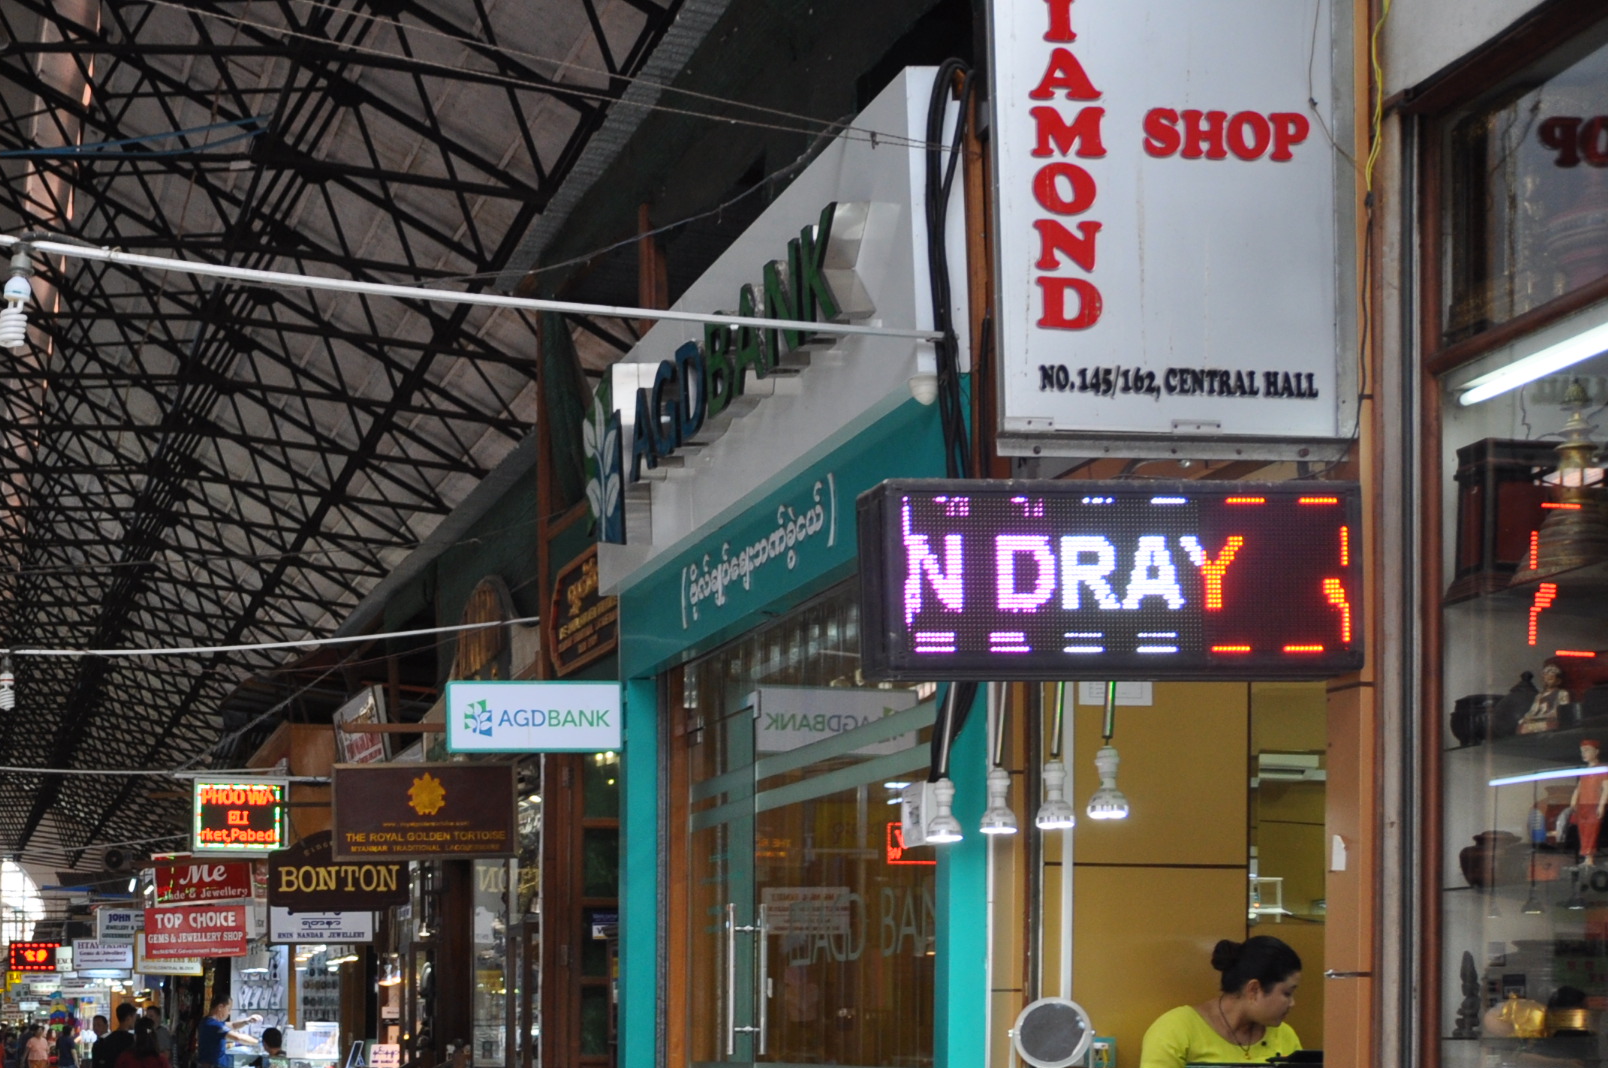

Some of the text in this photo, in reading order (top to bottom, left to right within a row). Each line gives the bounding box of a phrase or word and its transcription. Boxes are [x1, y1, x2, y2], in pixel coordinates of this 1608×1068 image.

[1142, 107, 1310, 162] SHOP
[630, 201, 842, 484] AGDBANK
[1163, 367, 1260, 398] CENTRAL
[1262, 370, 1319, 400] HALL
[498, 709, 611, 728] AGDBANK
[345, 830, 507, 843] THE ROYAL GOLDEN TORTOISE
[178, 864, 228, 886] Me
[277, 864, 401, 894] BONTON
[199, 886, 249, 899] Jewellery
[108, 913, 131, 924] JOHN
[154, 911, 237, 929] TOP CHOICE
[147, 930, 244, 944] GEMS & JEWELLERY SHOP
[327, 931, 365, 939] JEWELLERY
